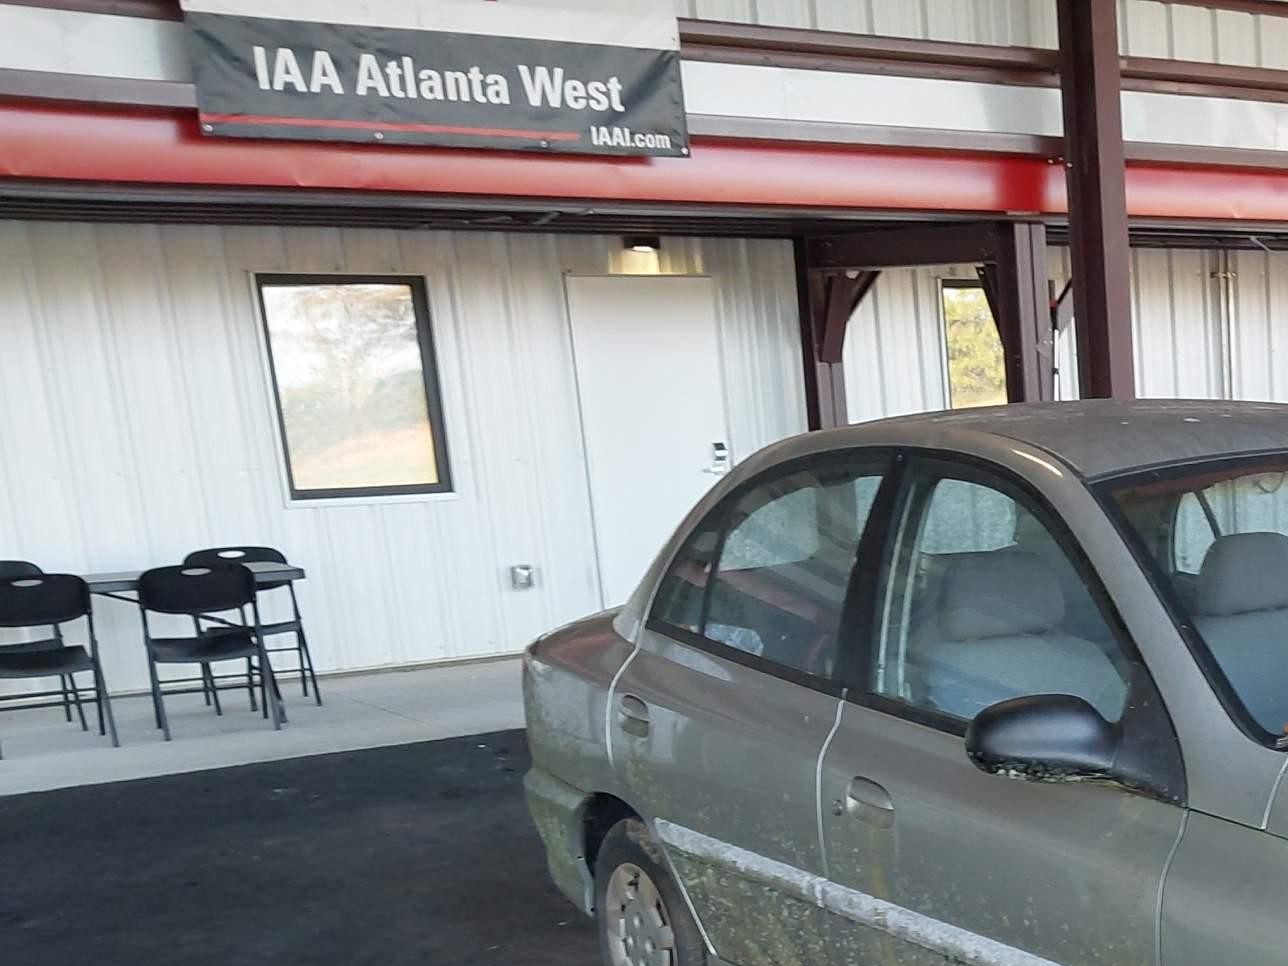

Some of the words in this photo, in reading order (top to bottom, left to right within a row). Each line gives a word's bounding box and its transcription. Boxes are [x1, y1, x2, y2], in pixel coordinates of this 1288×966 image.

[252, 45, 344, 95] IAA
[356, 54, 510, 105] Atlanta
[517, 65, 626, 113] West
[590, 125, 672, 150] IAAI.com
